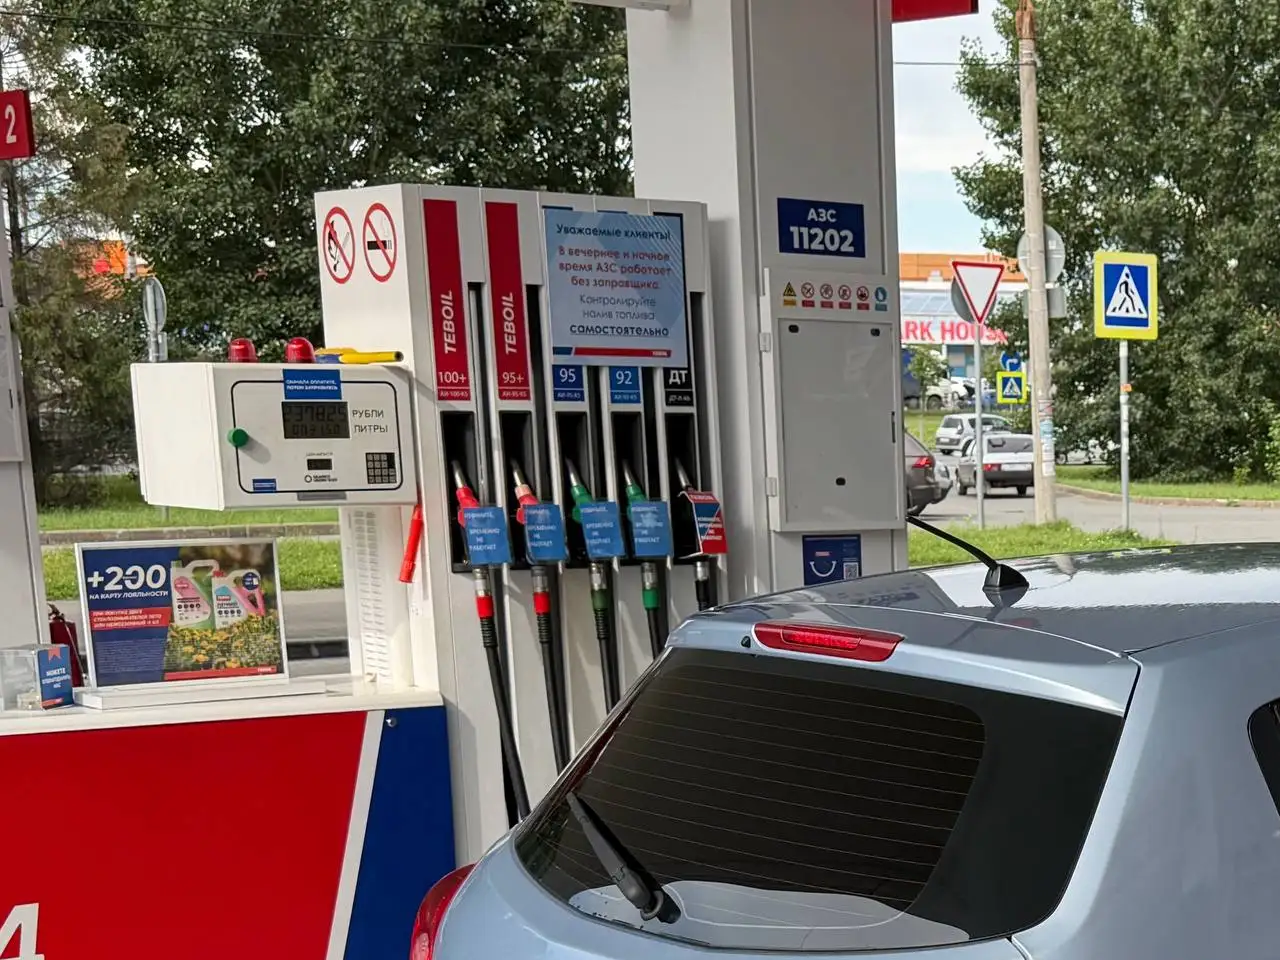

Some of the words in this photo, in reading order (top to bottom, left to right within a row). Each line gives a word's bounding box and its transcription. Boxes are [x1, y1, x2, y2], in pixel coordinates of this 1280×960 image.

[5, 104, 17, 144] 2
[807, 208, 837, 223] АЗС
[556, 223, 621, 237] Уважаемые
[624, 230, 670, 240] клиенты!
[789, 226, 855, 253] 11202
[558, 246, 566, 256] В
[568, 248, 620, 259] вечернее
[623, 251, 630, 259] и
[632, 252, 670, 261] ночное
[559, 263, 592, 273] время
[596, 262, 617, 273] АЗС
[620, 264, 671, 276] работает
[570, 276, 590, 286] без
[580, 294, 656, 307] Контролируйте
[440, 290, 457, 354] TEBOIL
[583, 310, 613, 319] налив
[615, 311, 655, 320] топлива
[501, 292, 517, 355] TEBOIL
[569, 324, 669, 336] самостоятельно
[438, 371, 466, 383] 100+
[502, 372, 524, 384] 95+
[559, 368, 577, 383] 95
[615, 370, 633, 385] 92
[668, 370, 688, 385] ДТ
[352, 409, 384, 418] РУБЛИ
[354, 424, 388, 433] ЛИТРЫ
